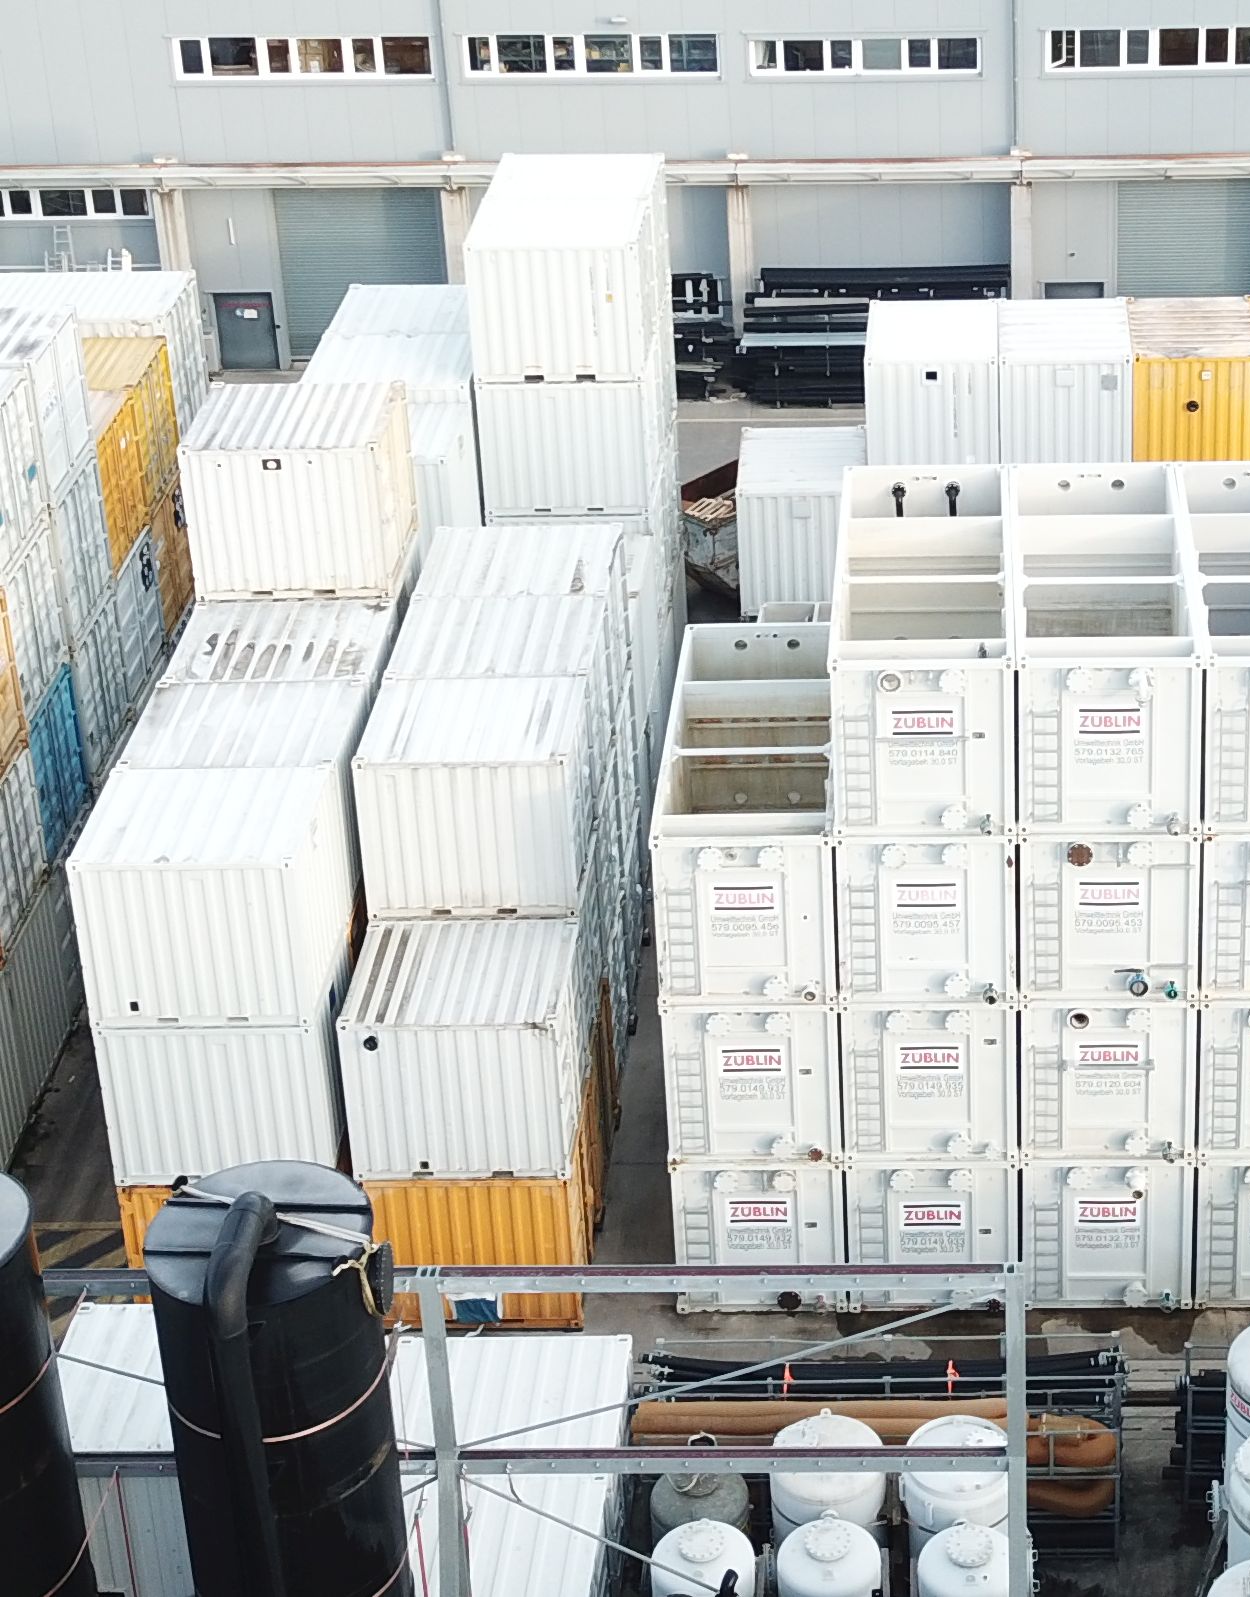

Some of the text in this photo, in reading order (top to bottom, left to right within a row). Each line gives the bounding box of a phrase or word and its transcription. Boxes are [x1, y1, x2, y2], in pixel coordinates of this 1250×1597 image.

[892, 717, 953, 728] ZÜBLIN
[1079, 715, 1141, 727] ZÜBLIN
[714, 893, 774, 904] ZÜBLIN
[897, 890, 957, 900] ZÜBLIN
[1080, 888, 1140, 899] ZÜBLIN
[722, 1055, 781, 1066] ZÜBLIN
[901, 1052, 959, 1063] ZÜBLIN
[1080, 1051, 1138, 1061] ZÜBLIN
[730, 1207, 787, 1216] ZÜBLIN
[904, 1210, 961, 1220] ZÜBLIN
[1079, 1207, 1136, 1216] ZÜBLIN
